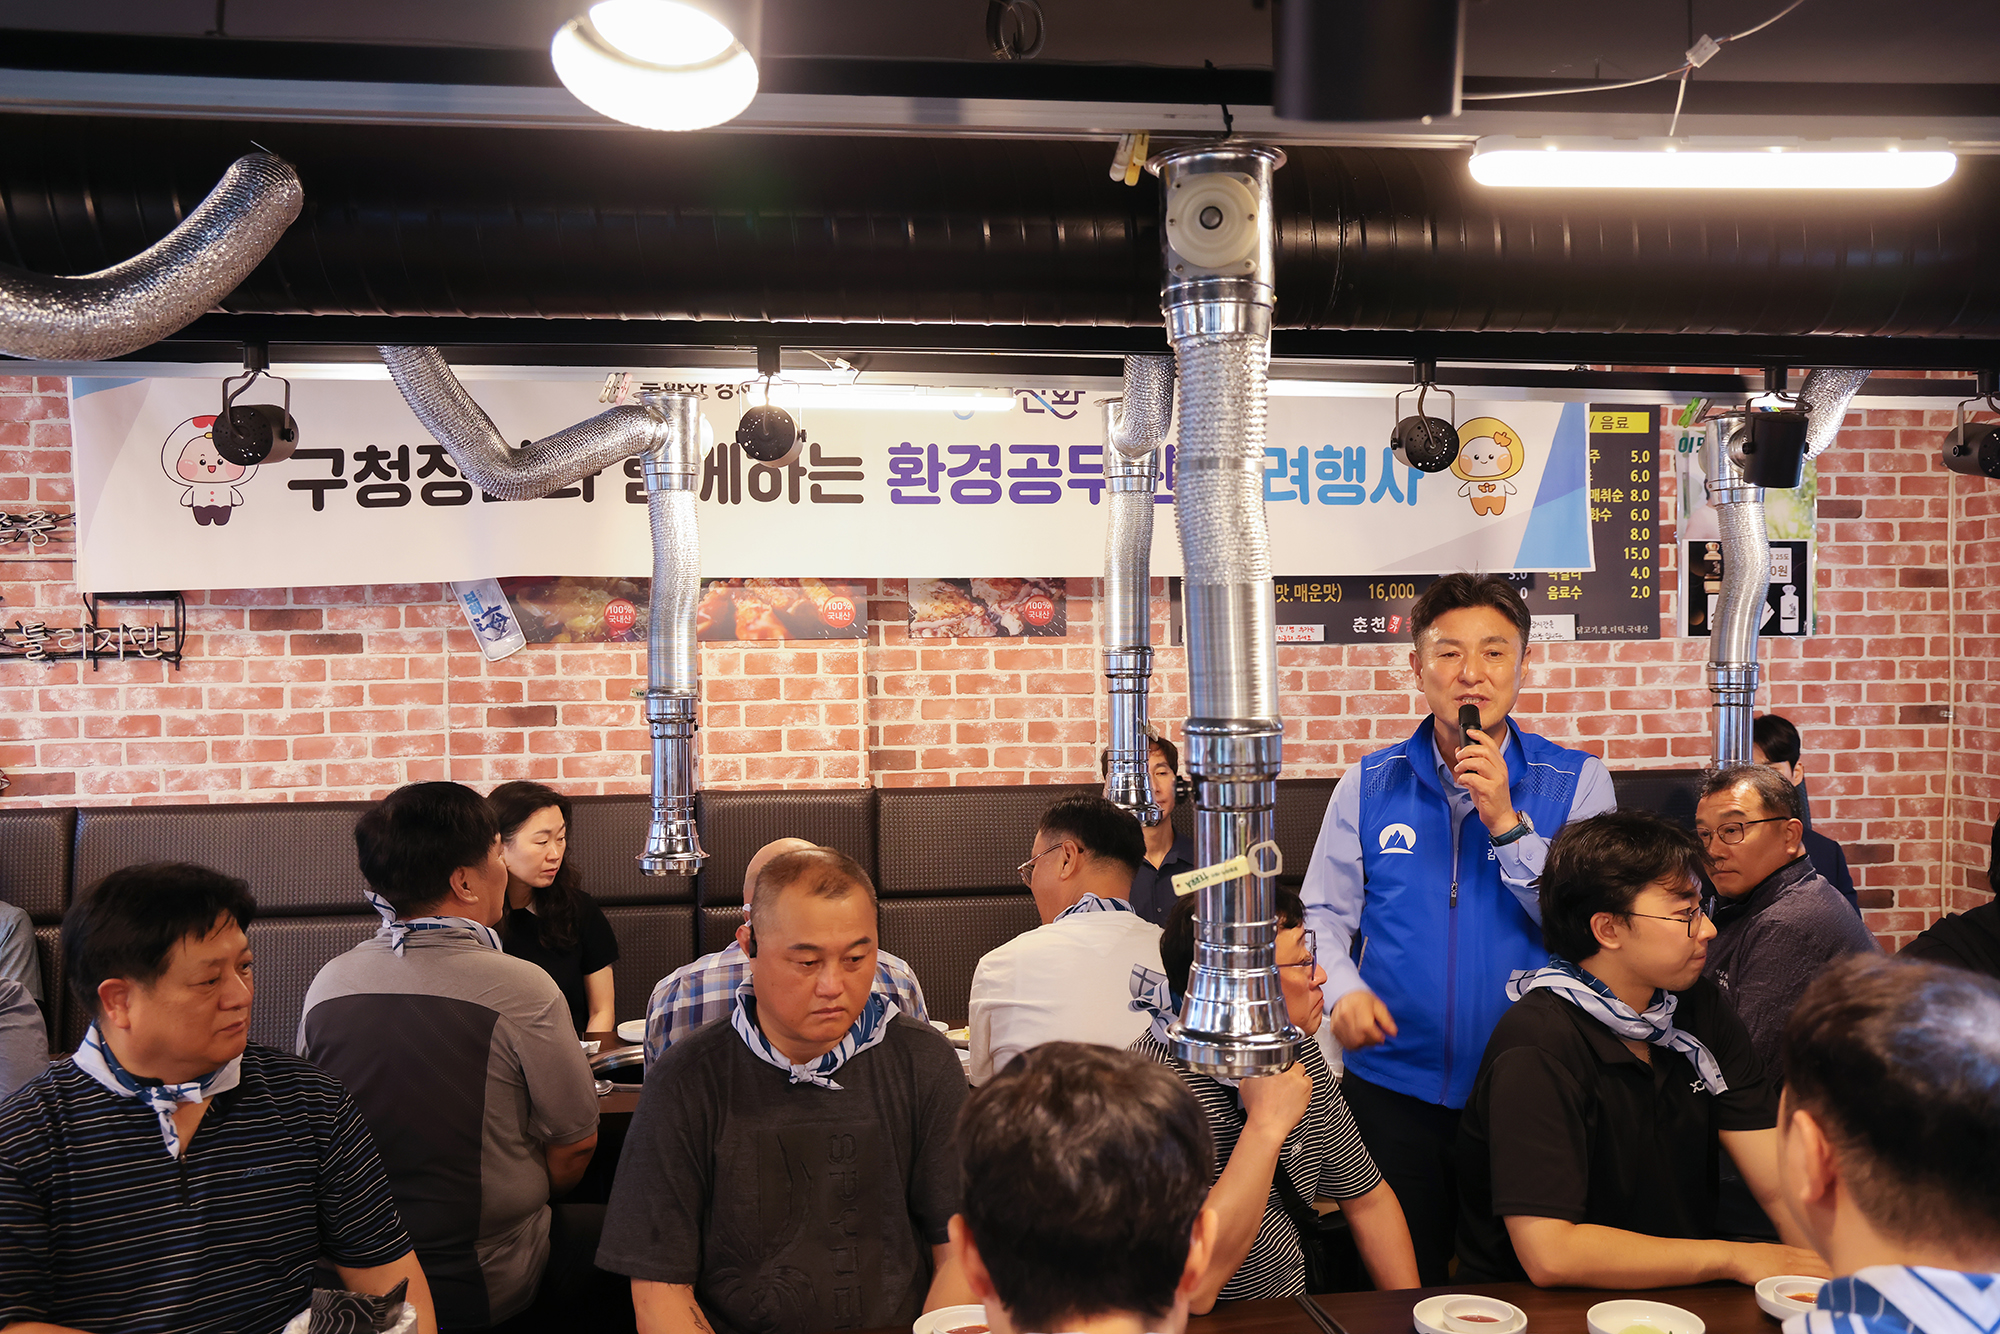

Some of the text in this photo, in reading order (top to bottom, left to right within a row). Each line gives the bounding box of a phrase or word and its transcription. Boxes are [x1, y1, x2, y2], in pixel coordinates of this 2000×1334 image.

[1601, 416, 1629, 430] 음료
[1631, 450, 1650, 464] 5.0
[1263, 444, 1425, 506] 려행사
[1630, 469, 1650, 483] 6.0
[1630, 489, 1650, 502] 8.0
[1630, 508, 1650, 521] 6.0
[1630, 527, 1650, 541] 8.0
[1624, 547, 1650, 560] 15.0
[1630, 566, 1650, 580] 4.0
[1368, 583, 1415, 602] 16,000
[1547, 585, 1650, 600] 음료수 2.0
[609, 605, 631, 614] 100%
[828, 601, 851, 610] 100%
[1029, 601, 1050, 610] 100%
[608, 615, 631, 624] 국내산
[827, 611, 851, 620] 국내산
[1028, 611, 1050, 620] 국내산
[1353, 616, 1386, 633] 춘천
[828, 1132, 863, 1334] SPYDE
